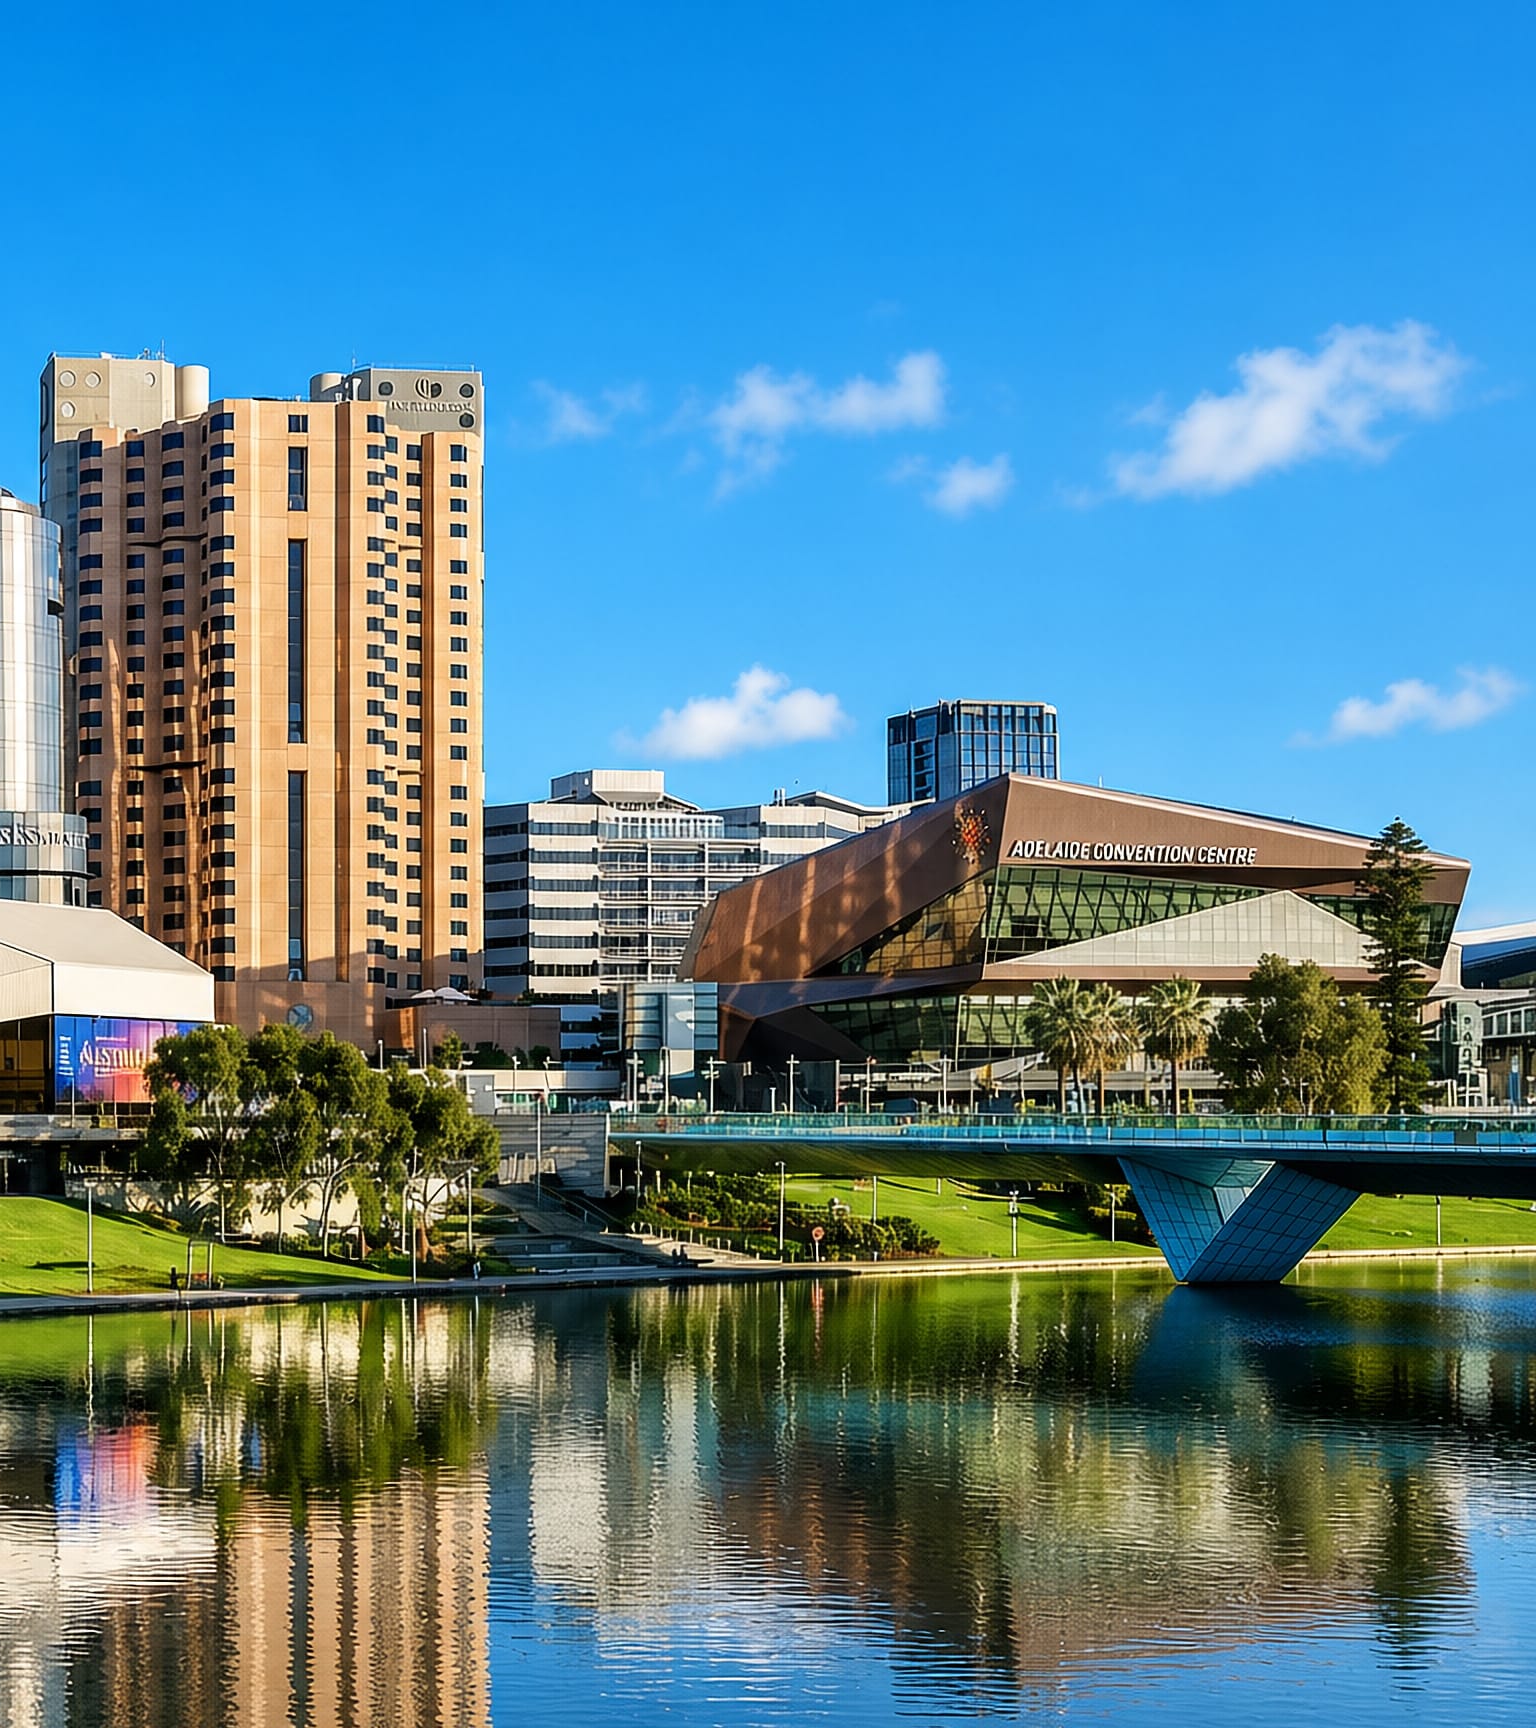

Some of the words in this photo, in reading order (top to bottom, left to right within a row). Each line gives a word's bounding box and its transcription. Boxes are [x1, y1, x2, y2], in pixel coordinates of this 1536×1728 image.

[1010, 840, 1091, 860] ADELAIDE
[1093, 843, 1195, 863] CONVENTION
[1197, 846, 1258, 866] CENTRE
